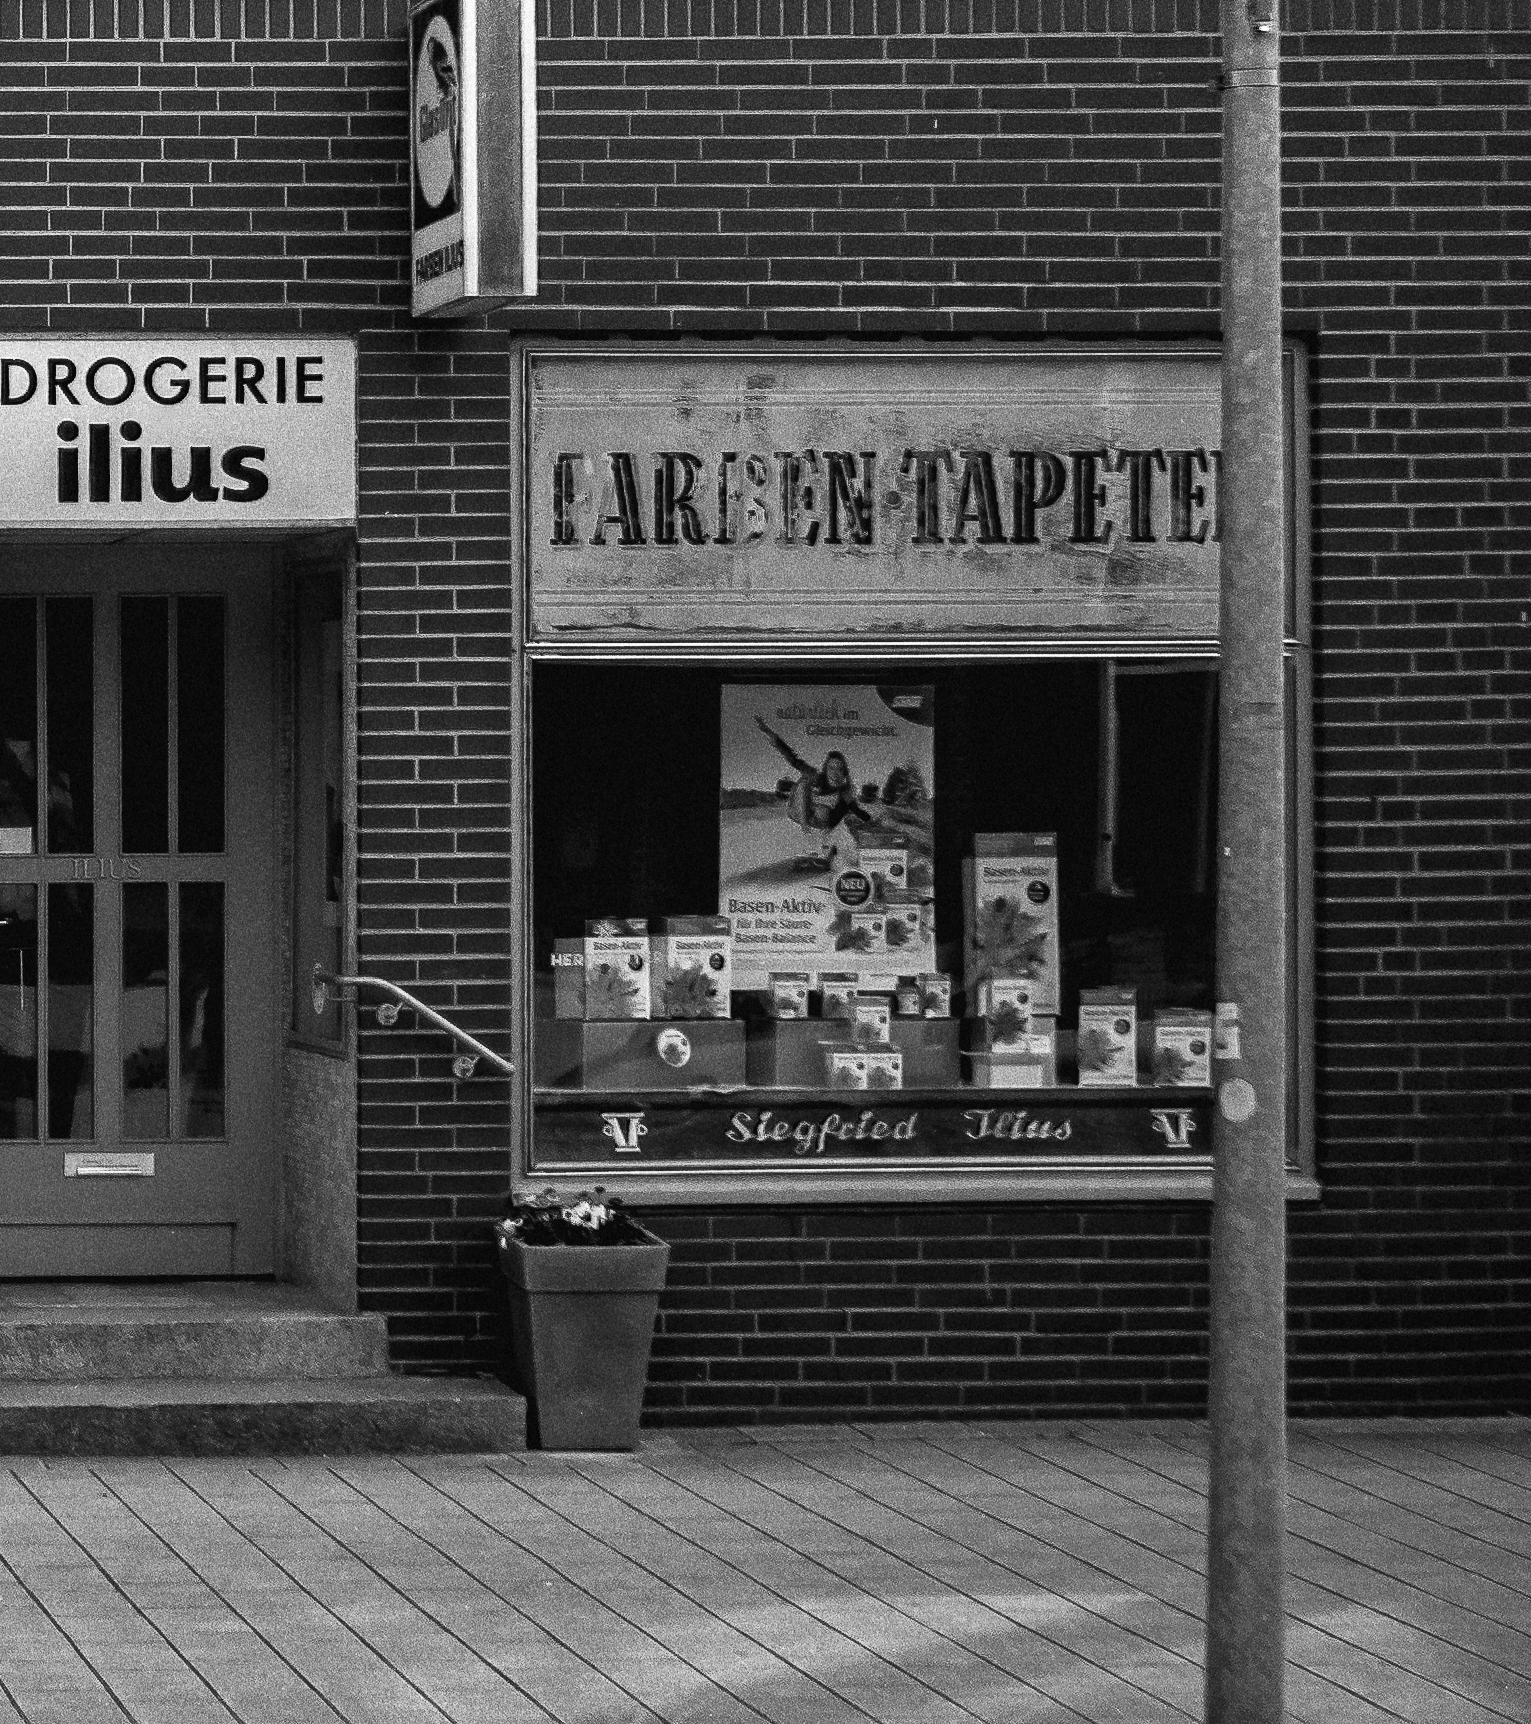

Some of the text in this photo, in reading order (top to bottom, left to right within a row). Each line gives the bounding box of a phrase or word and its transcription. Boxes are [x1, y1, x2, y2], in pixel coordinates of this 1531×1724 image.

[0, 356, 324, 406] DROGERIE
[56, 420, 269, 504] ilius
[902, 449, 1222, 547] TAPETE
[725, 1108, 919, 1153] Siegfried
